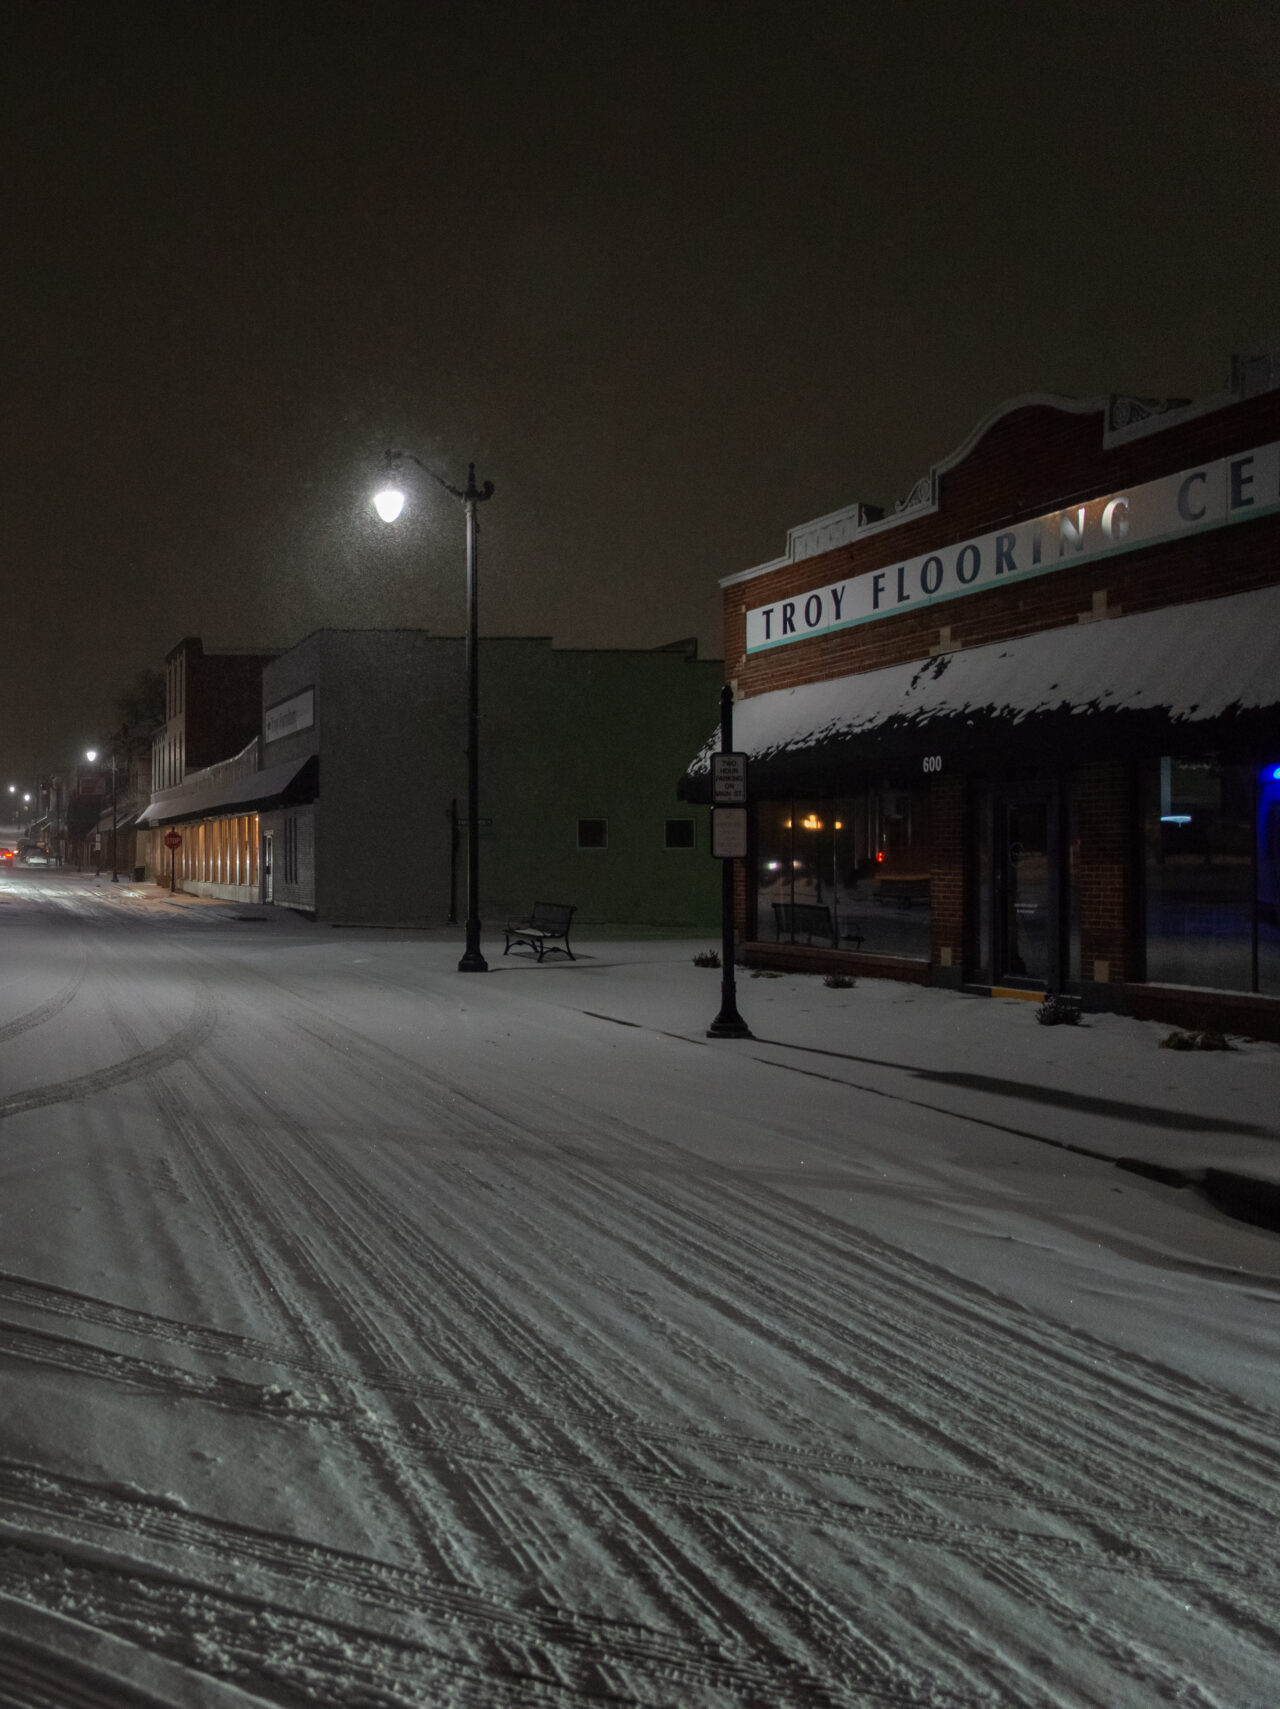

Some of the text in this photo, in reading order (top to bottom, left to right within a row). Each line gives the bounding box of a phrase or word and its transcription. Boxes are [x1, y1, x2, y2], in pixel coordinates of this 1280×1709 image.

[761, 450, 1280, 640] TROY FLOORING CE
[922, 755, 943, 774] 600
[166, 837, 181, 845] STOP
